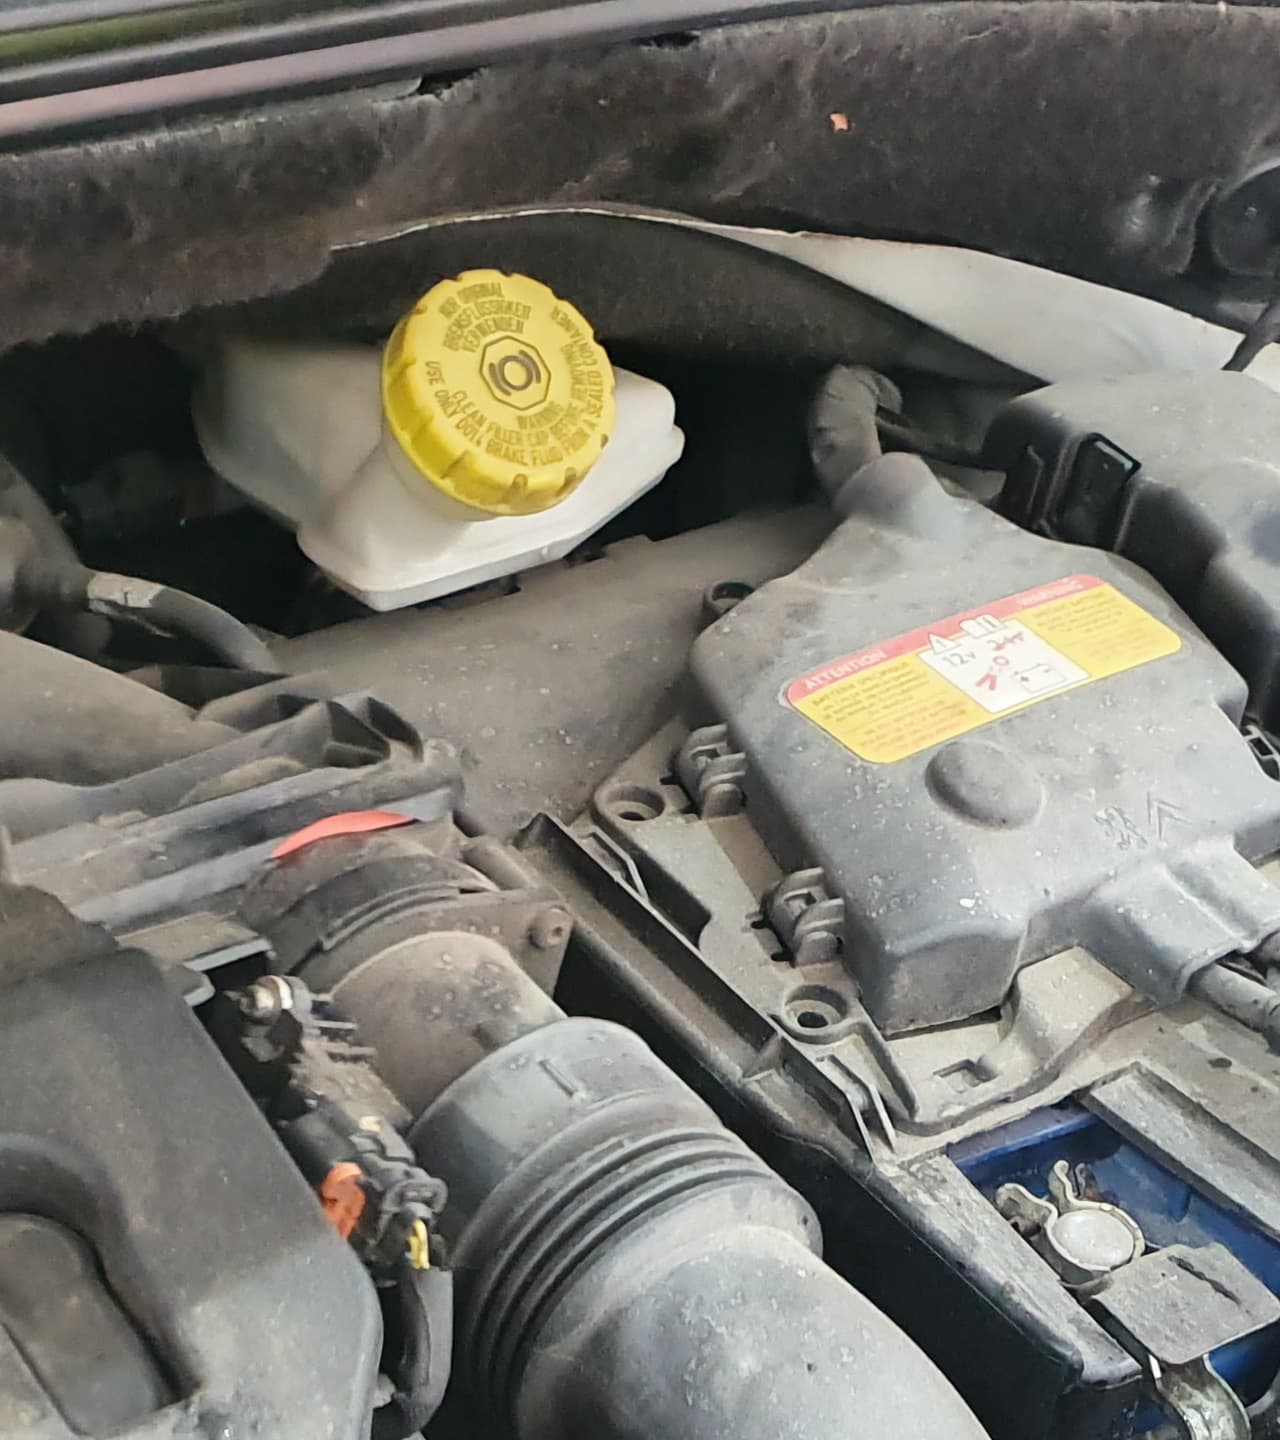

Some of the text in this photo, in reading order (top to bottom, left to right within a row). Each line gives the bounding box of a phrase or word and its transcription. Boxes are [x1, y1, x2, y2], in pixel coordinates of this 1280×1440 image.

[549, 305, 599, 366] CONTAINER
[425, 360, 441, 386] USE
[434, 389, 460, 419] ONLY
[452, 390, 487, 428] CLEAN
[582, 370, 604, 418] SEALED
[486, 438, 528, 467] BRAKE
[804, 649, 888, 690] ATTENTION
